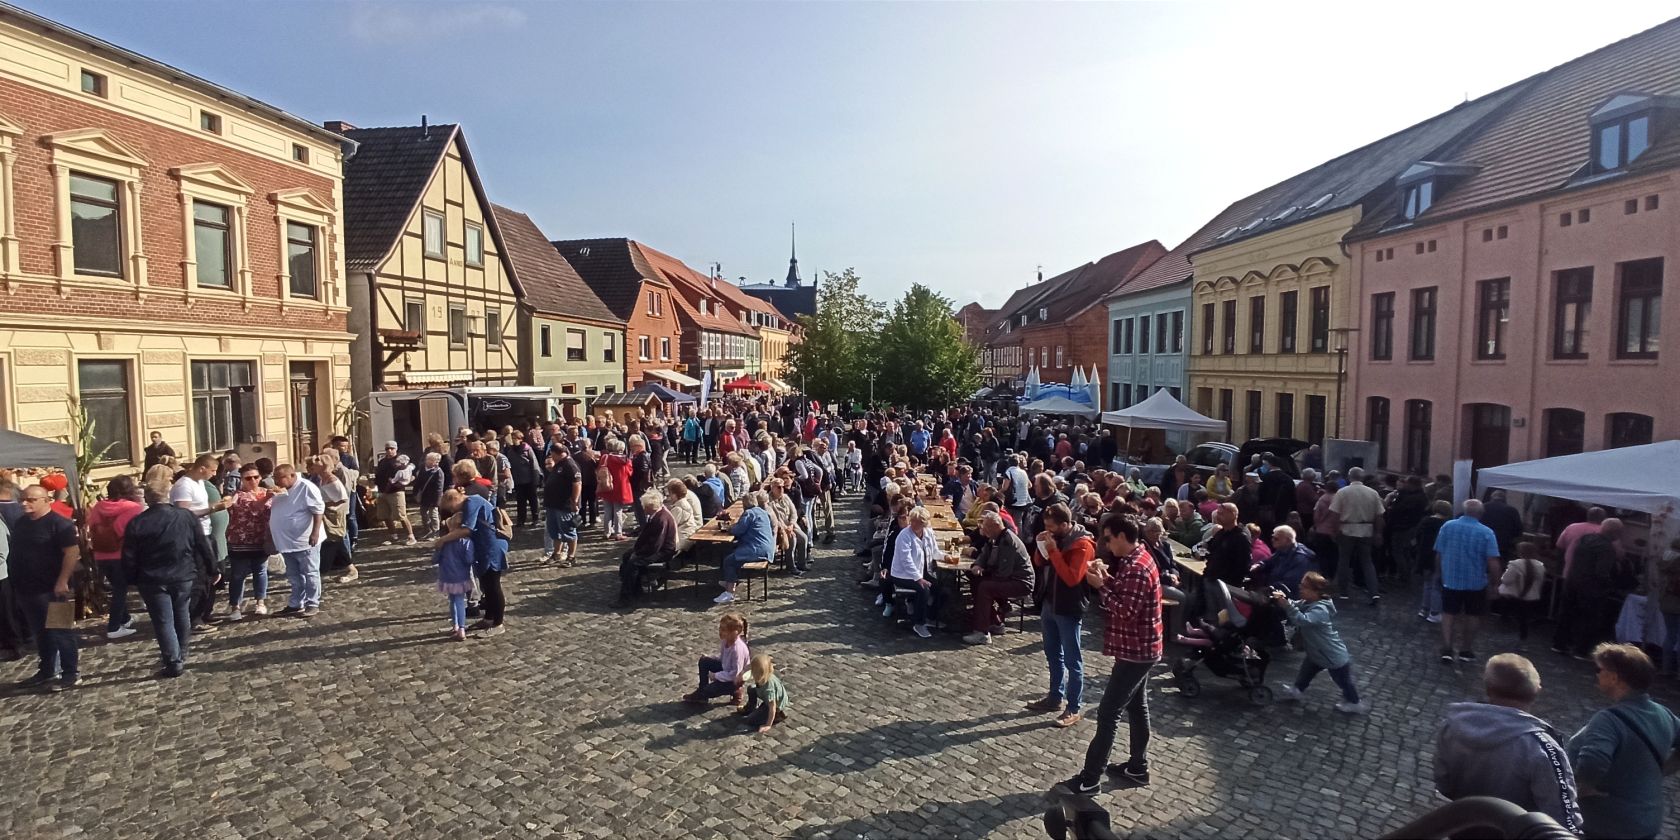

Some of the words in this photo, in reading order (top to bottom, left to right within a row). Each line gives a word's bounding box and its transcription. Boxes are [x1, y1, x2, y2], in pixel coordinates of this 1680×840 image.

[432, 306, 443, 319] 19
[1545, 742, 1560, 766] DAVID
[1556, 767, 1568, 790] CAMP
